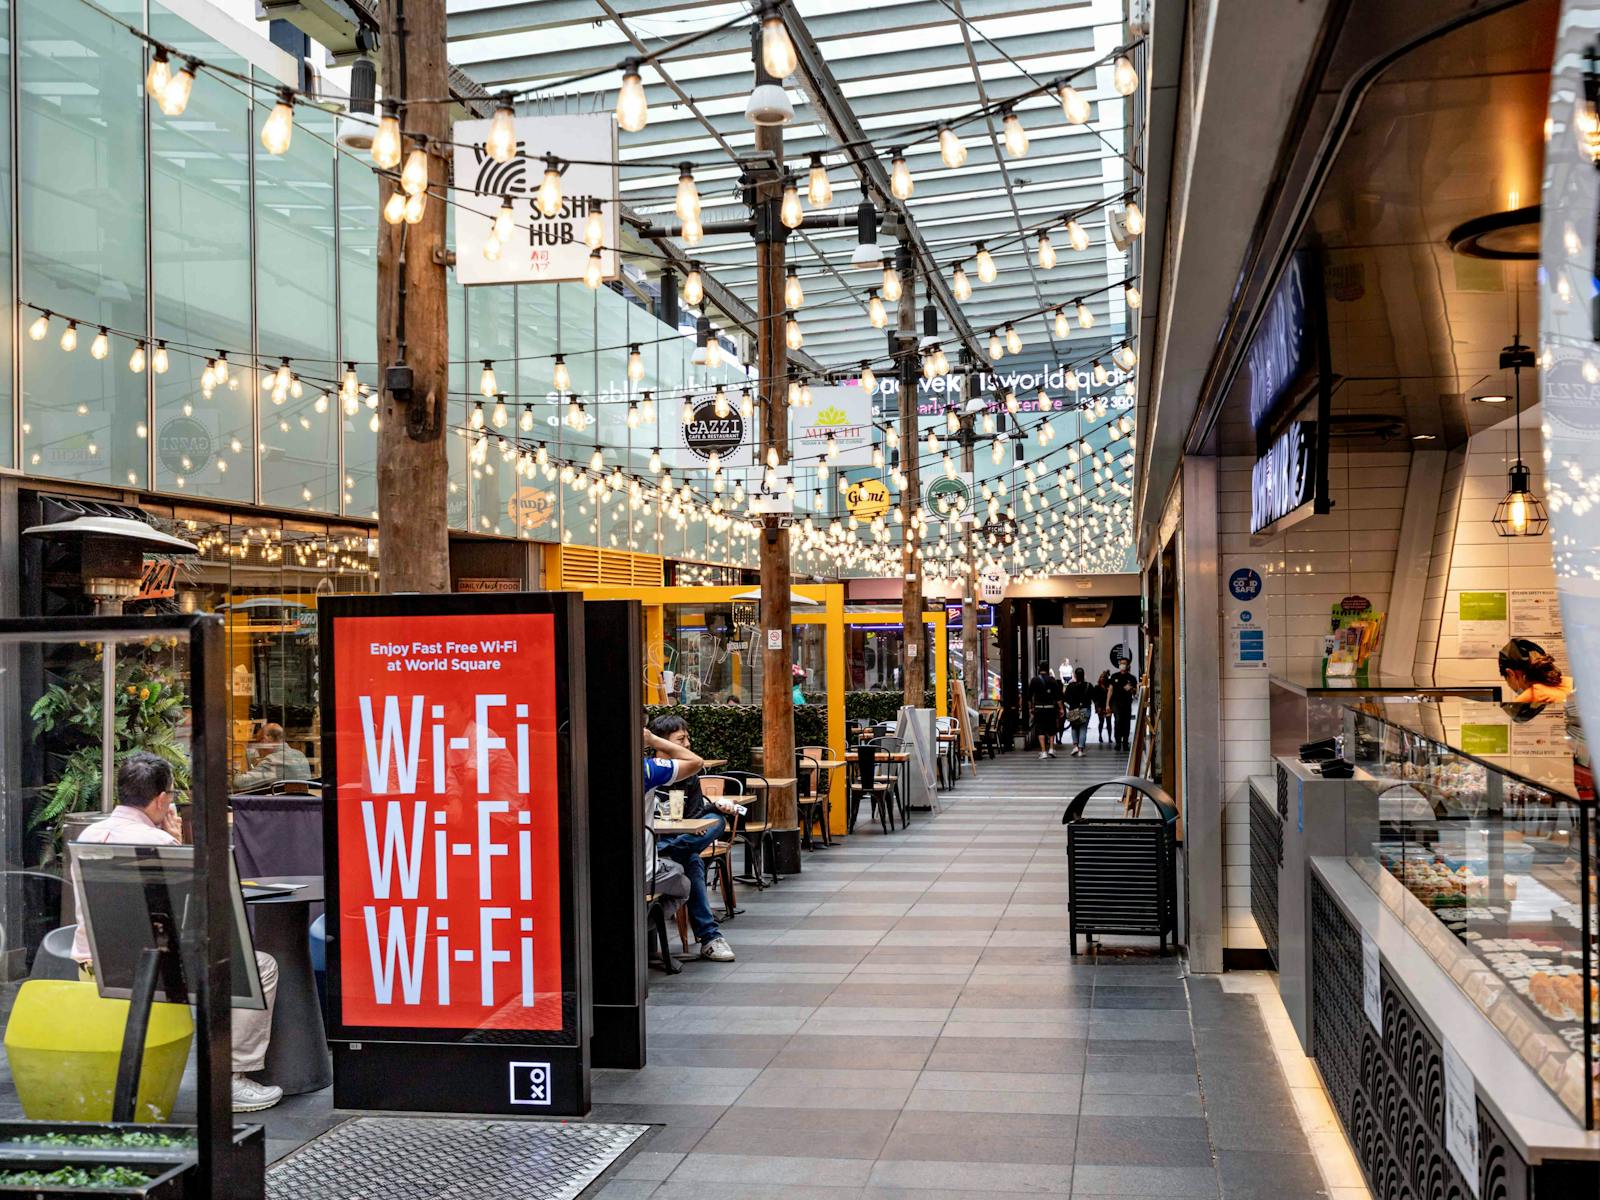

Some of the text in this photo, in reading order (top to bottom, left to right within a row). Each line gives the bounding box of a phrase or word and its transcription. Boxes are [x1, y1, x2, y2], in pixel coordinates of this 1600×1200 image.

[529, 195, 592, 221] SSHI
[529, 222, 574, 247] HUB
[916, 399, 945, 416] arly
[687, 420, 740, 434] GAZZI
[848, 490, 885, 506] Gmi
[370, 640, 518, 657] Enjoy Fast Free Wi-Fi
[387, 658, 501, 673] at World Square
[359, 694, 530, 794] Wi-Fi
[361, 800, 532, 901] Wi-Fi
[363, 906, 534, 1007] Wi-Fi
